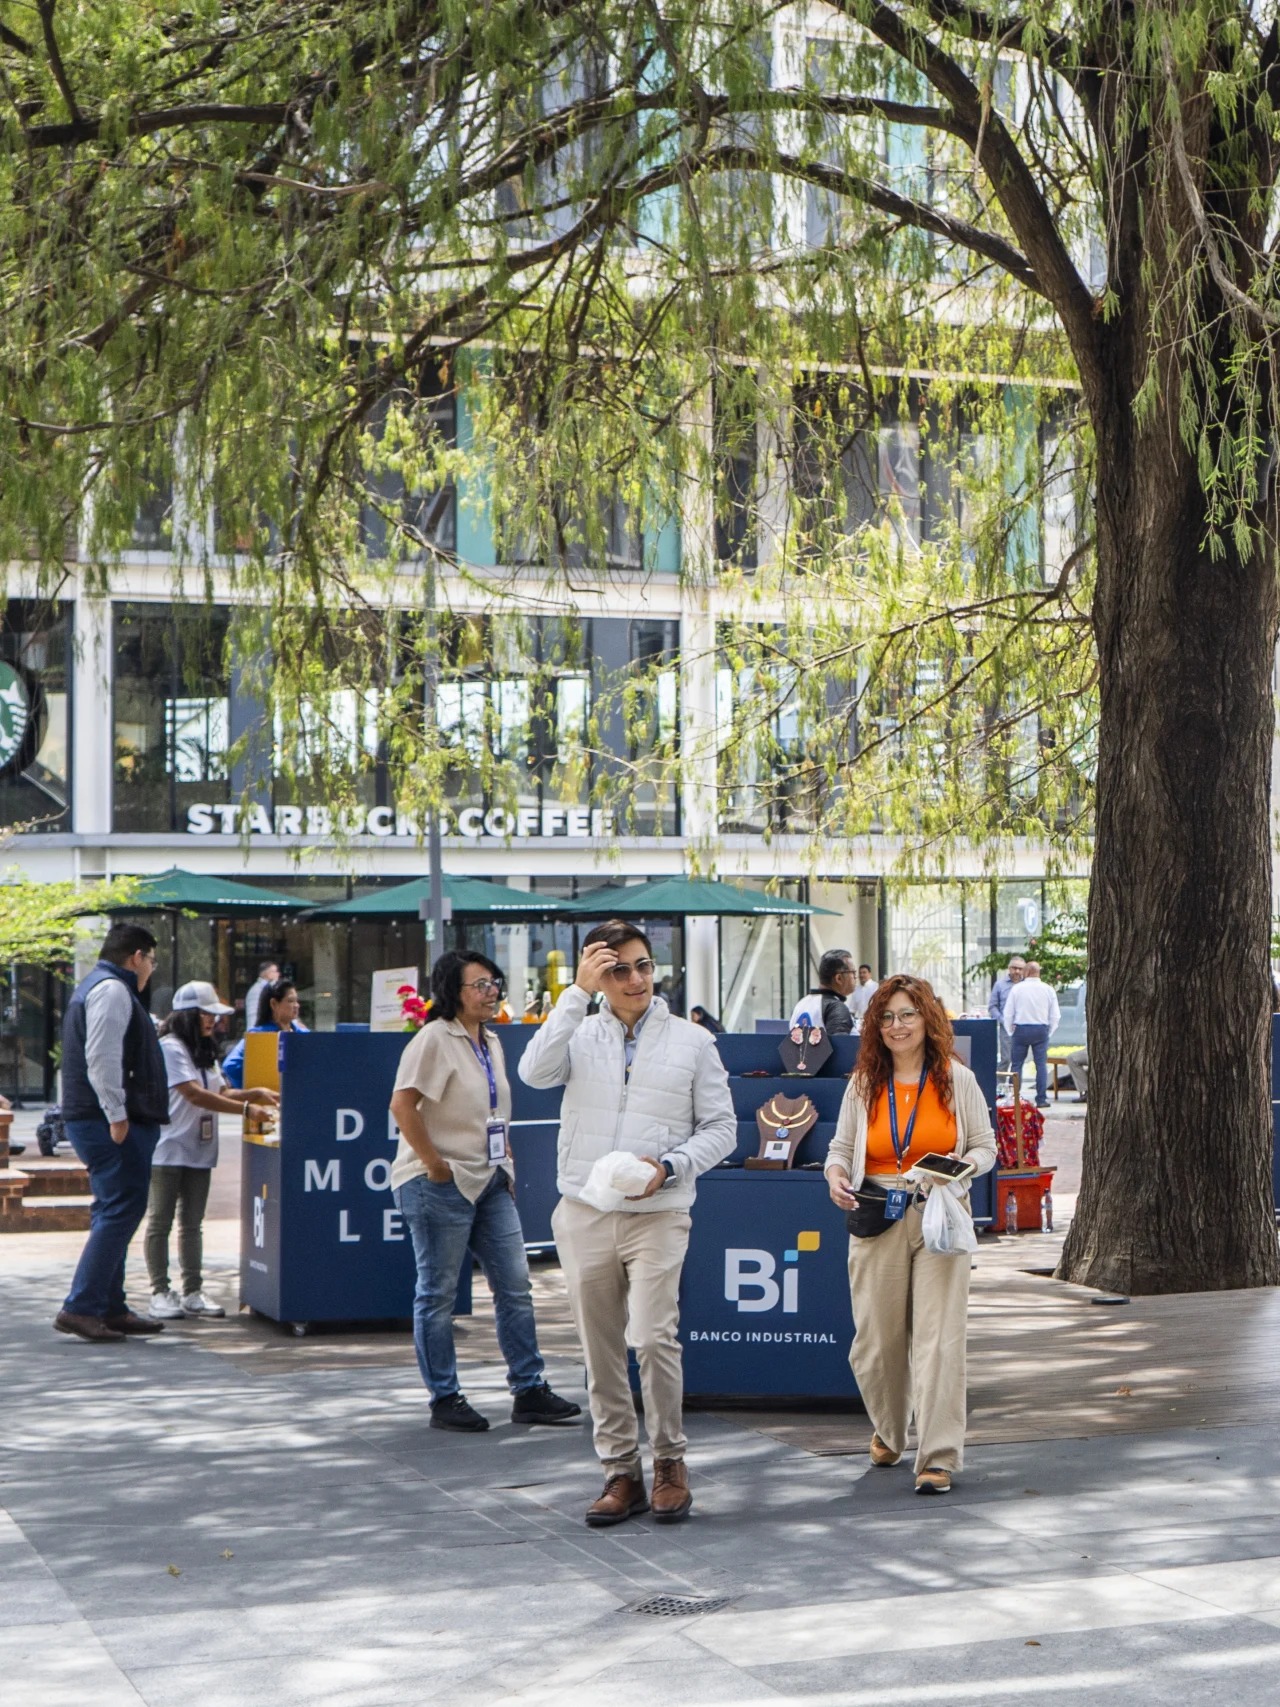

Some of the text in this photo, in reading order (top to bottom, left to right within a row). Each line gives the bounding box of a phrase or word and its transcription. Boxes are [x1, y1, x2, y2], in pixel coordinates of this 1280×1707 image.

[458, 807, 613, 837] COFFEE
[303, 1158, 393, 1192] MO
[724, 1248, 799, 1313] Bi
[690, 1331, 837, 1344] BANCO INDUSTRIAL
